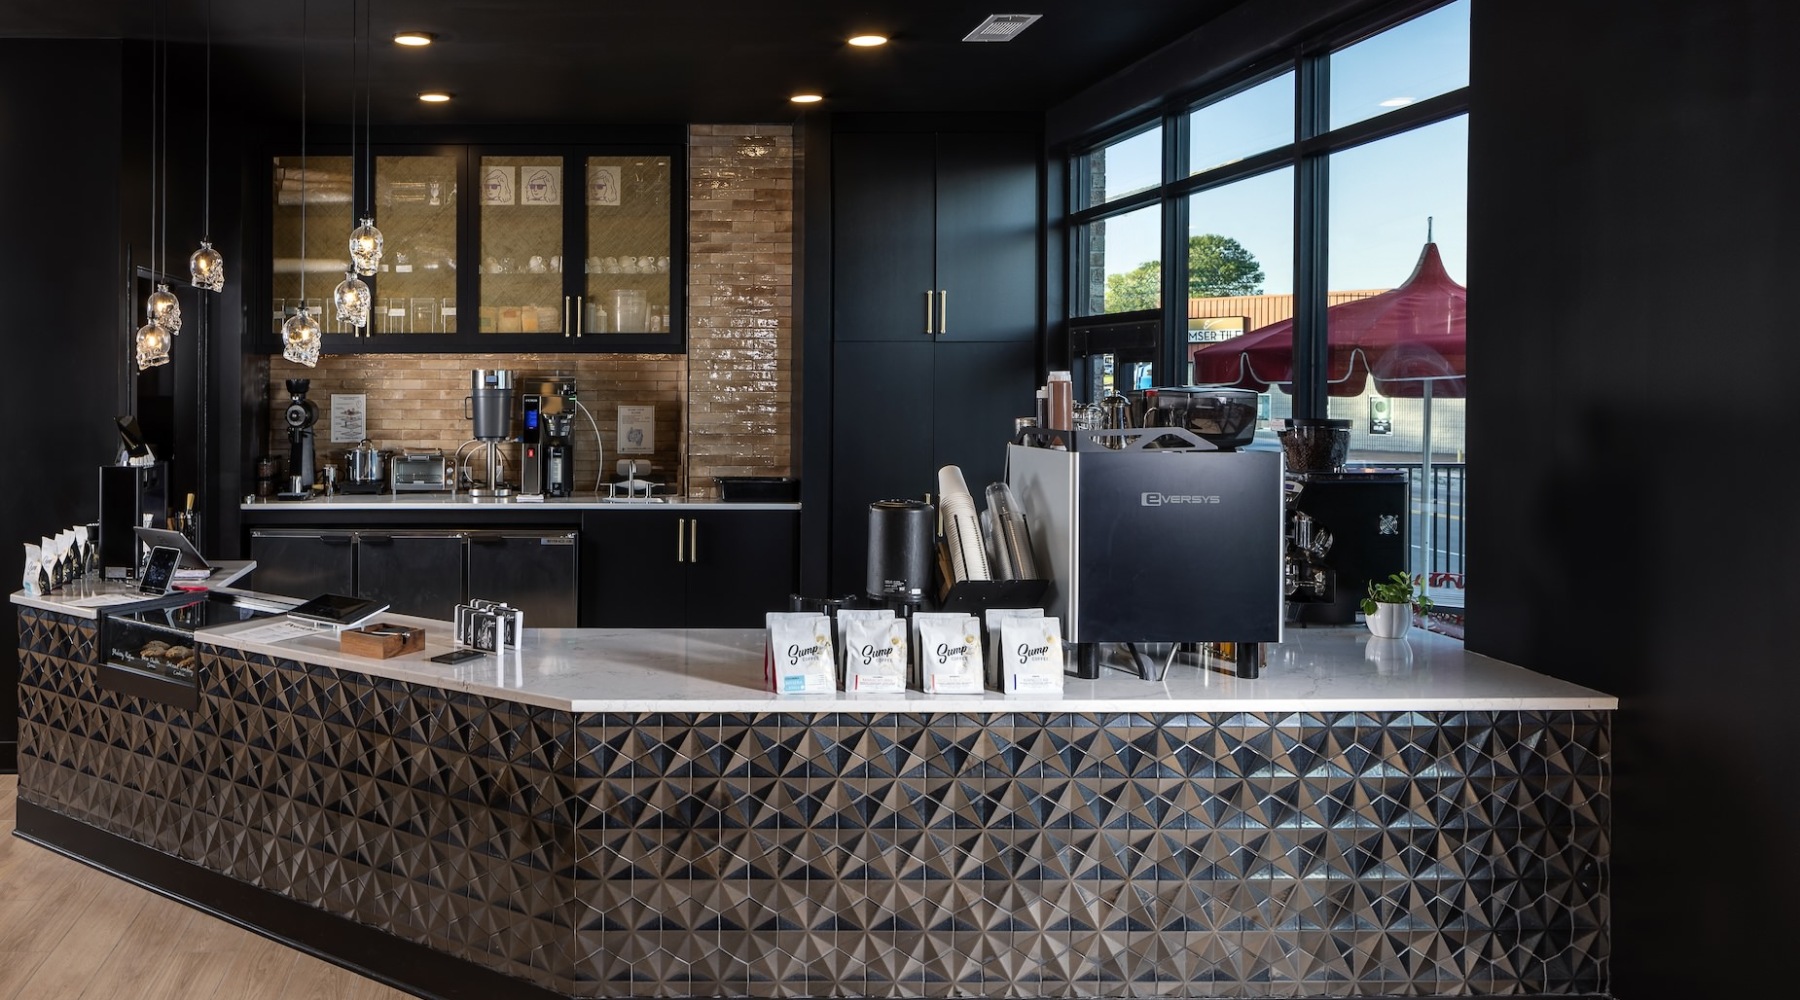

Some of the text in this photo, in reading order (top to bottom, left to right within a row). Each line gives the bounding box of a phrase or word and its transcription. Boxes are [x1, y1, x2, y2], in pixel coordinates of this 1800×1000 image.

[1188, 331, 1217, 341] MSER
[787, 644, 818, 666] Sump
[861, 644, 893, 666] Sump
[936, 643, 967, 664] Sump
[1017, 643, 1049, 664] Sump
